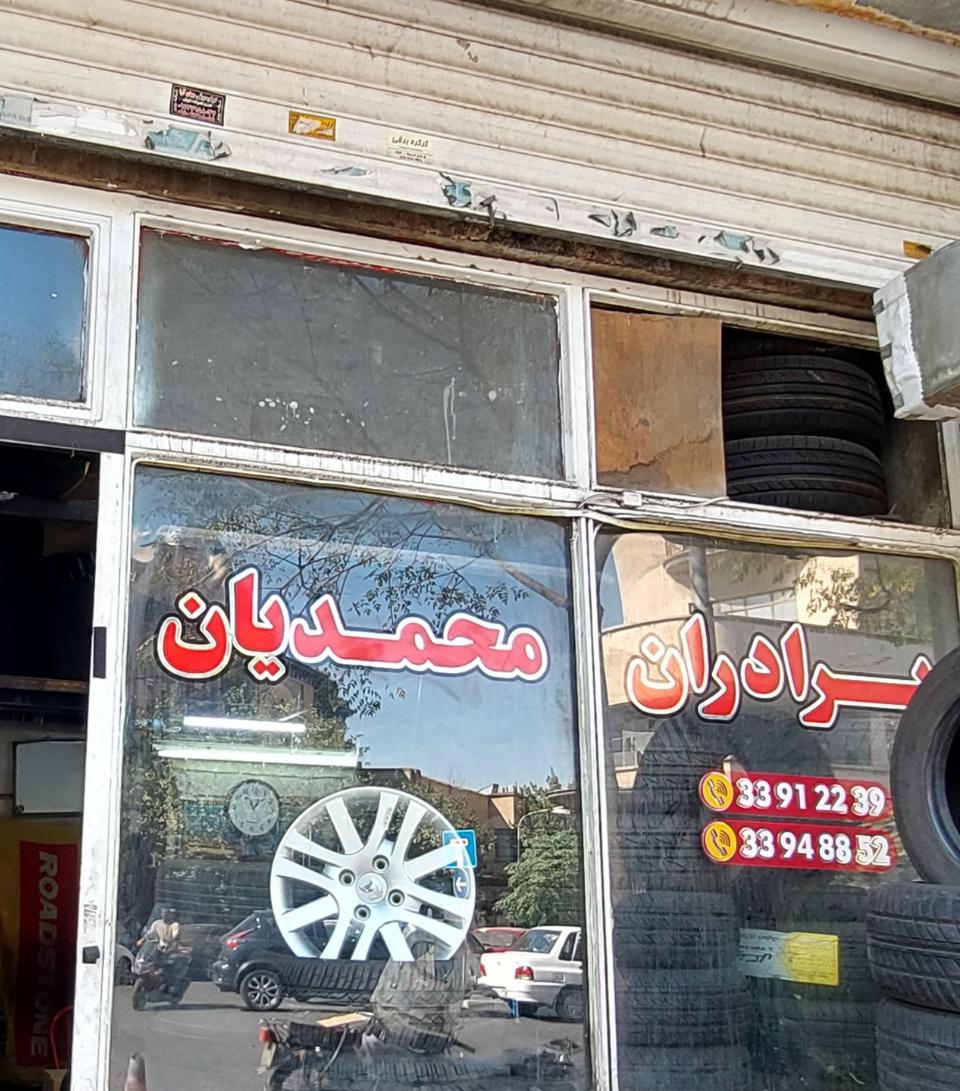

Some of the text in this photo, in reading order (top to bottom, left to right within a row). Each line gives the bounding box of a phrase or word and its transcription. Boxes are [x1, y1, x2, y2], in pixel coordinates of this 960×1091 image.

[157, 567, 548, 682] محمدیان
[737, 778, 772, 810] 33
[776, 782, 807, 810] 91
[814, 784, 848, 814] 22
[739, 827, 775, 858] 33
[779, 831, 815, 859] 94
[819, 833, 852, 864] 88
[31, 851, 59, 1058] ROADSTONE
